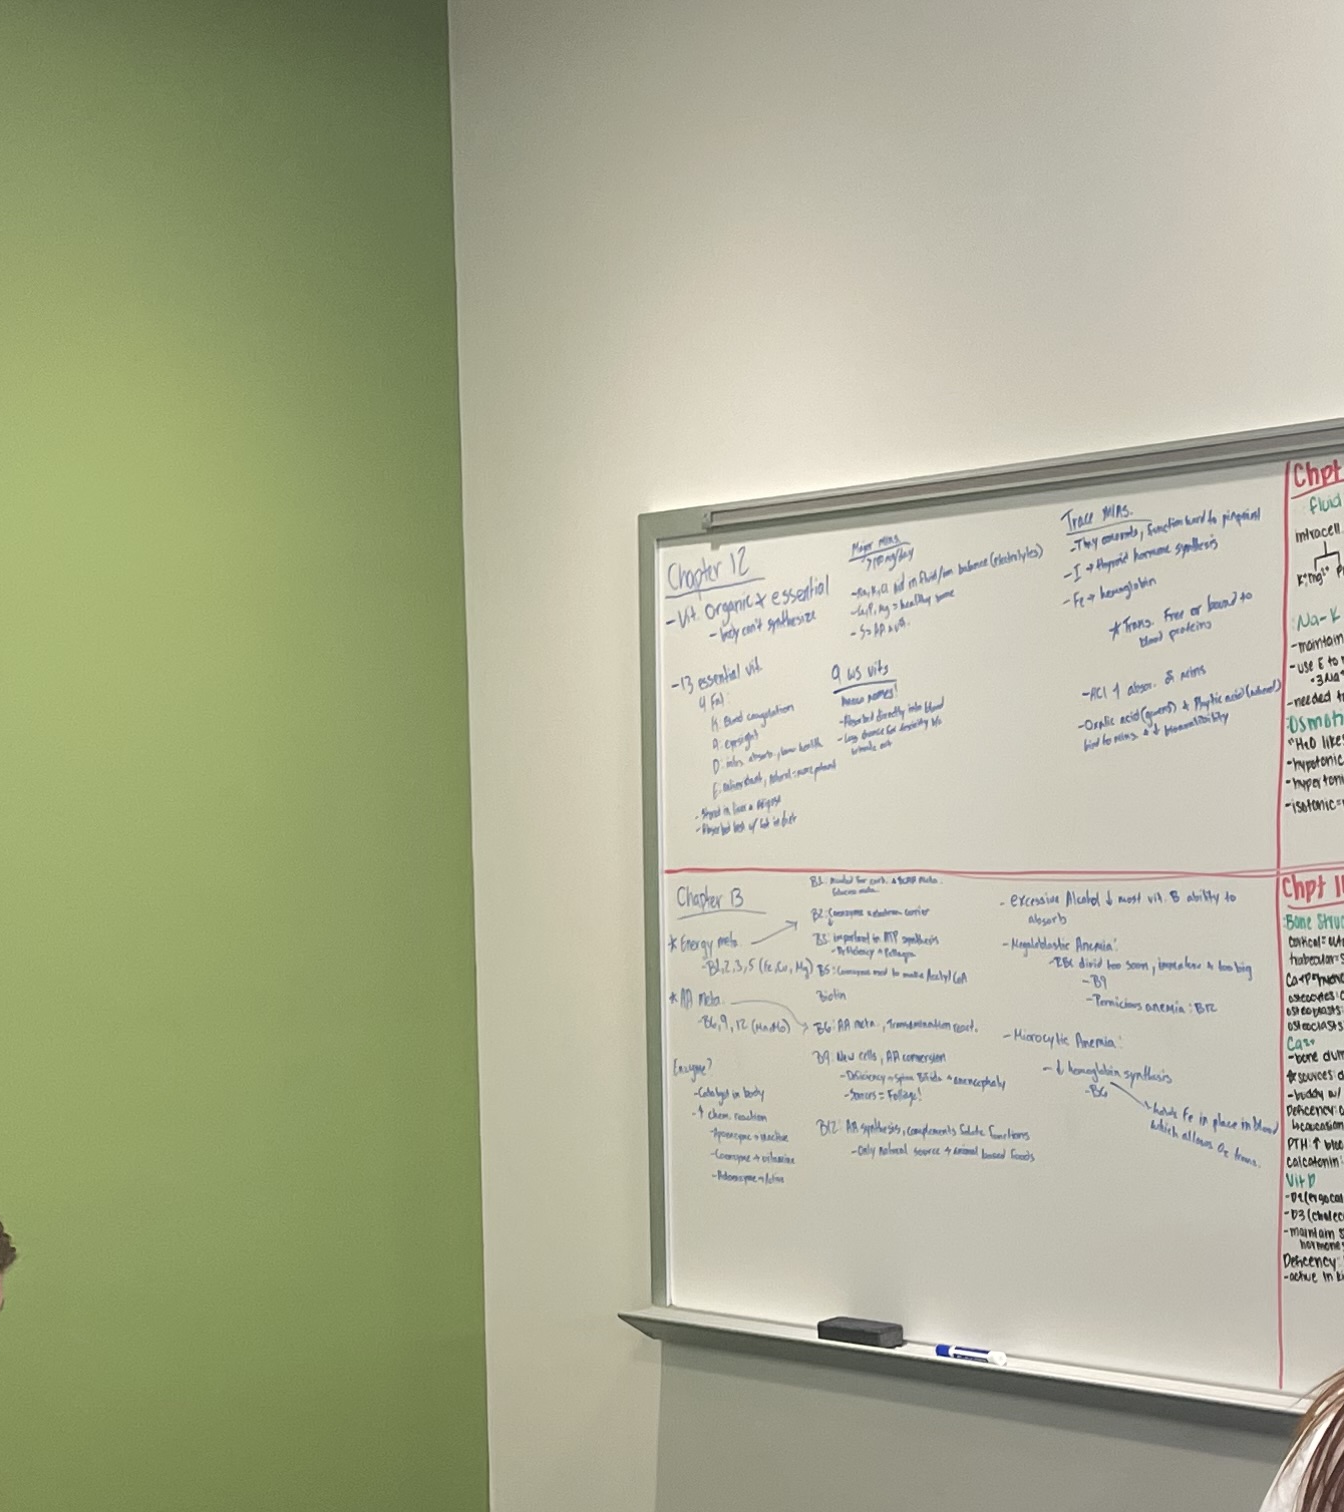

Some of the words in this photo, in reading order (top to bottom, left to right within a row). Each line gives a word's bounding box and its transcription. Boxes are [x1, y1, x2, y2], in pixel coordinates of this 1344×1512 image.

[1061, 509, 1093, 531] Trace
[668, 558, 721, 600] Chapter
[730, 546, 749, 576] 12
[772, 574, 828, 605] essential
[1328, 656, 1338, 667] to
[677, 886, 720, 910] Chapter
[1225, 891, 1236, 902] to
